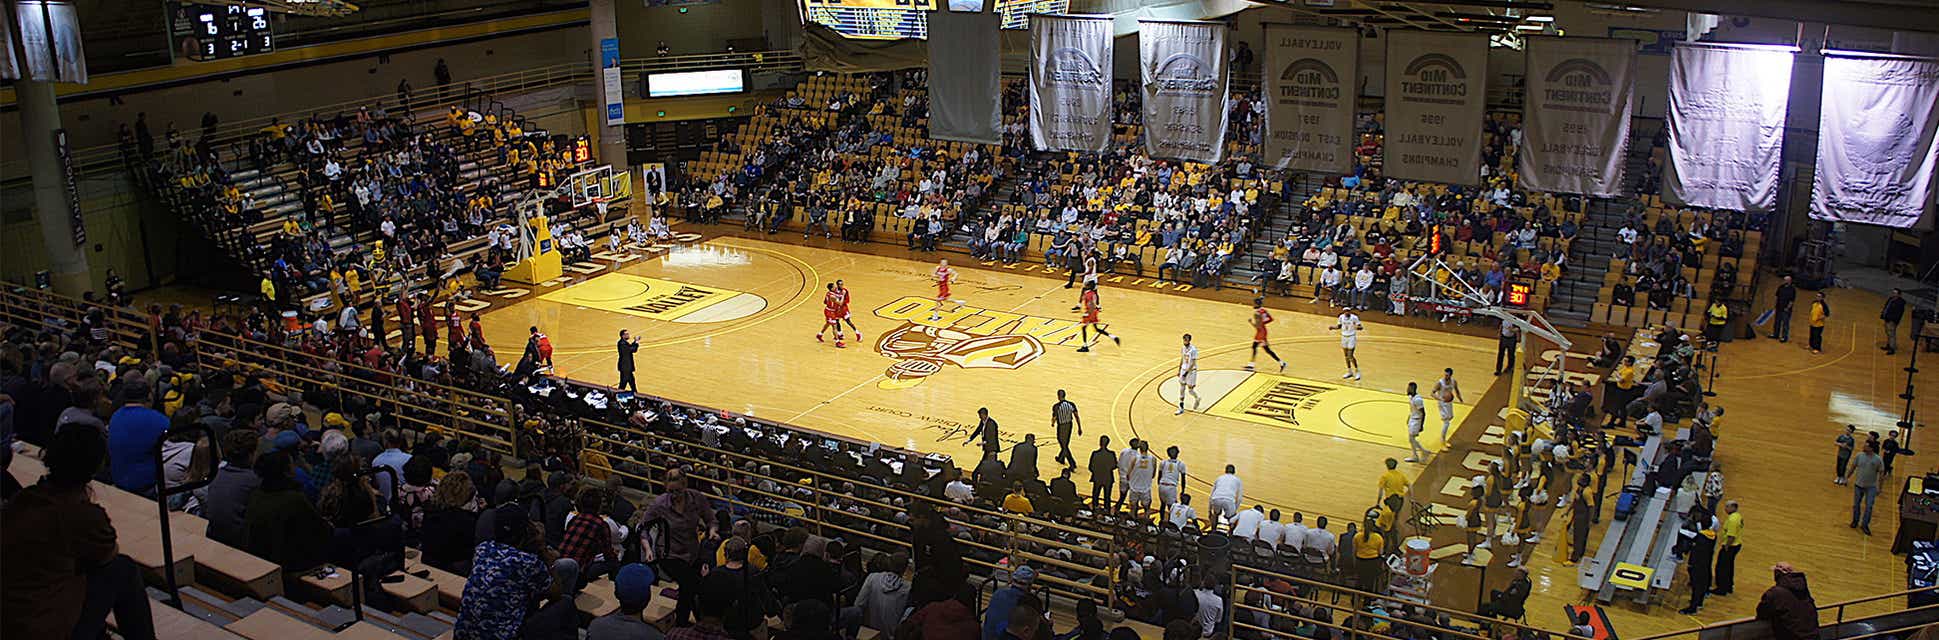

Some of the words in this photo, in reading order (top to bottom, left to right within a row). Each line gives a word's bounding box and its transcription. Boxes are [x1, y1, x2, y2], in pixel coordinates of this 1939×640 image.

[264, 36, 270, 46] 3
[208, 43, 214, 54] 3
[575, 147, 588, 161] 30
[621, 286, 714, 314] VALLEY
[1509, 292, 1526, 304] 30
[873, 296, 1109, 348] VALPO
[1244, 382, 1338, 426] VALLEY
